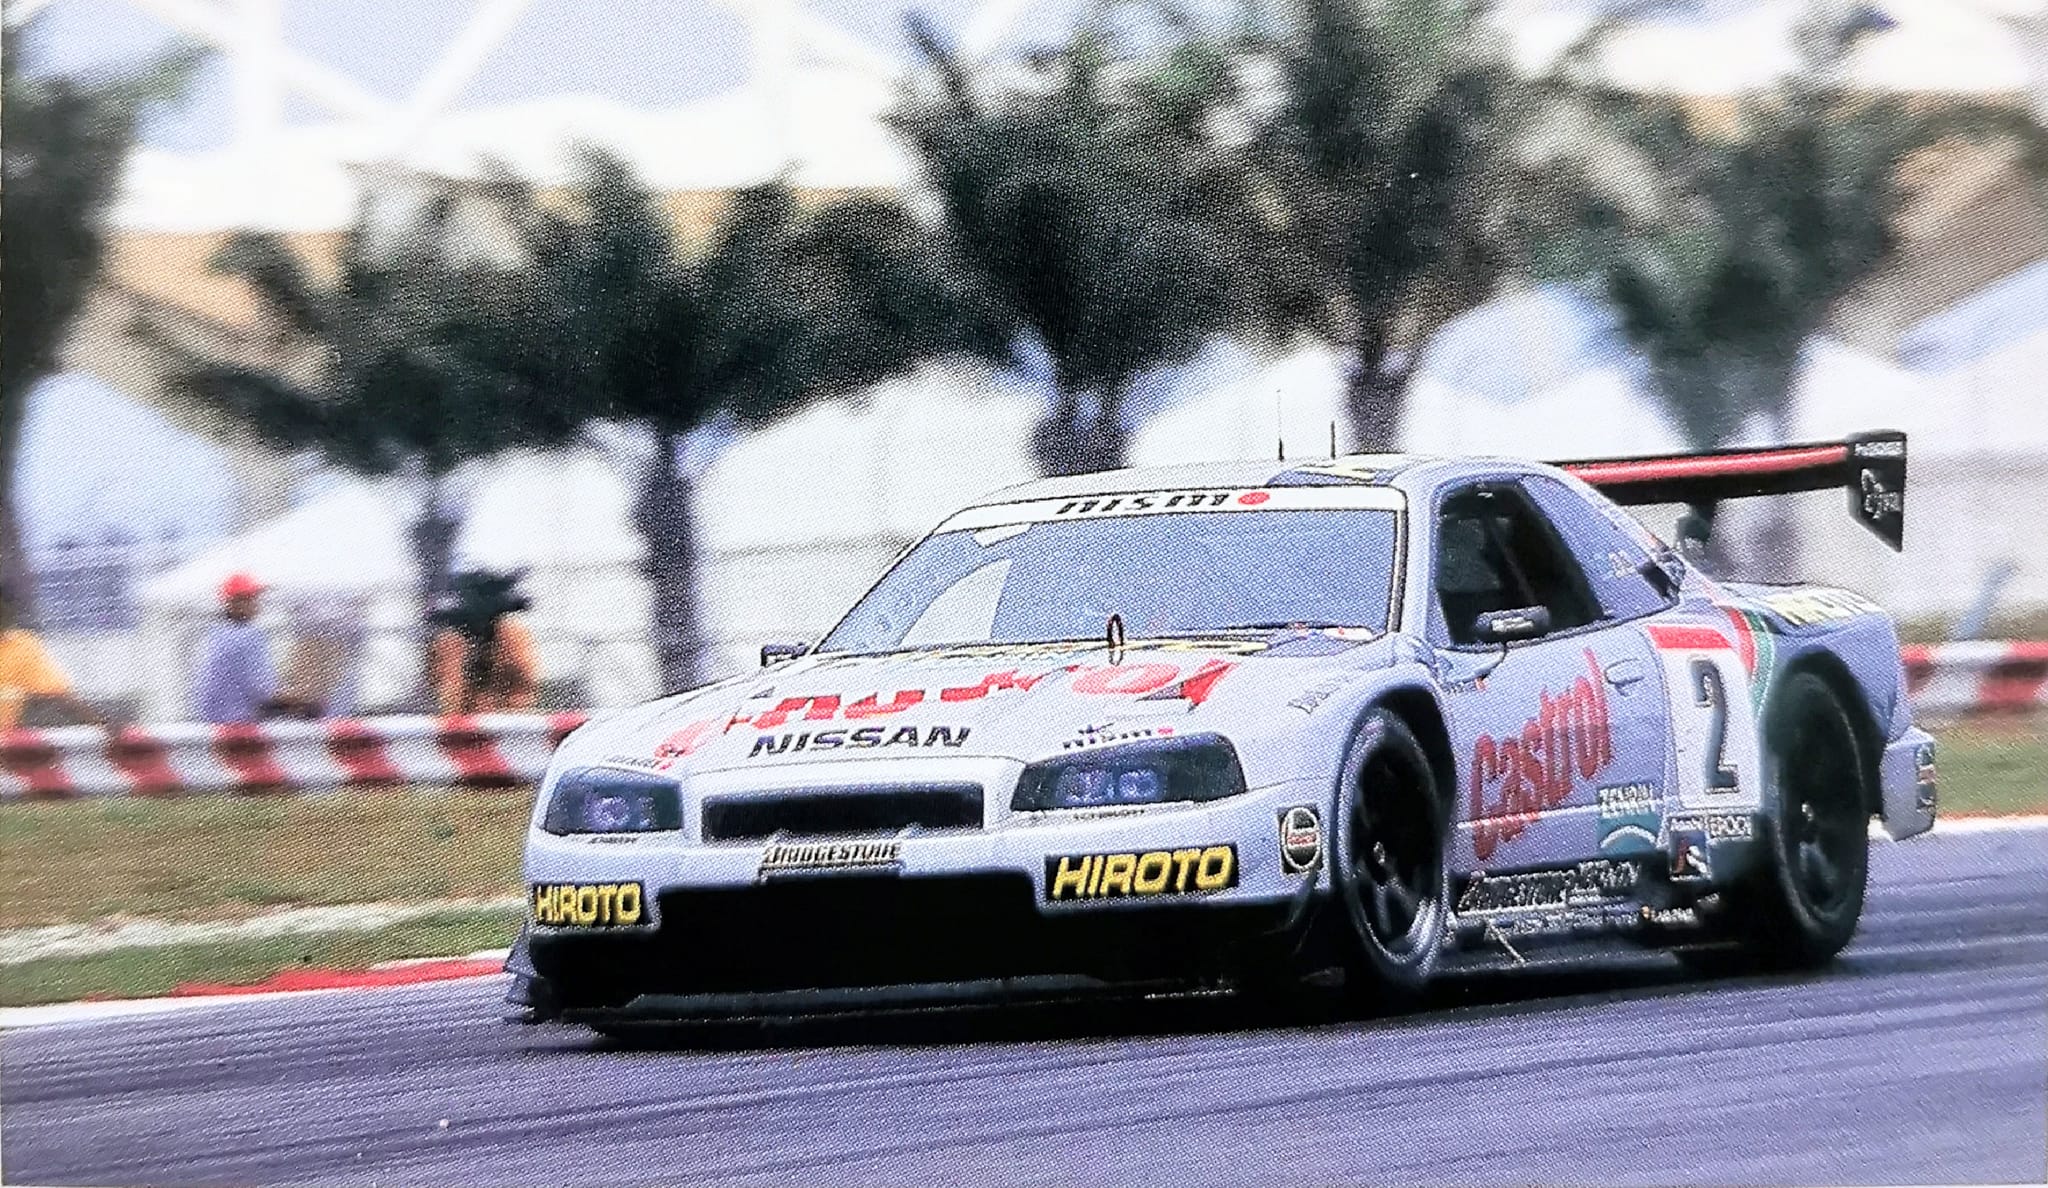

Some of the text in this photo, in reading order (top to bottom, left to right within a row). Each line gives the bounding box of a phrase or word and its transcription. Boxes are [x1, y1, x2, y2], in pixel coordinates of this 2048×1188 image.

[748, 726, 972, 758] NISSAN
[1688, 654, 1740, 794] 2
[1469, 646, 1615, 862] Castrol
[1053, 846, 1234, 898] HIROTO
[535, 883, 642, 926] HIROTO
